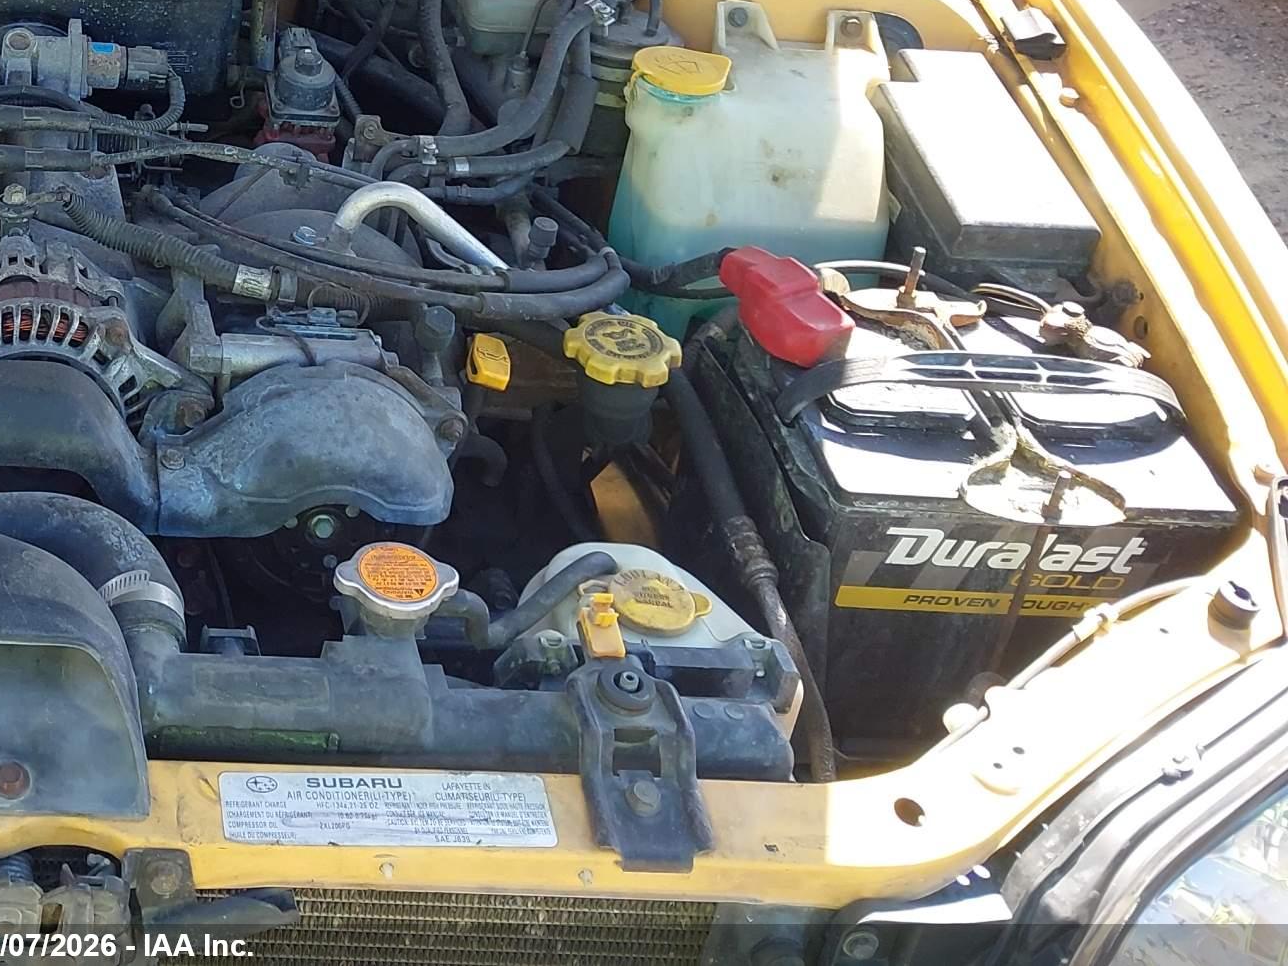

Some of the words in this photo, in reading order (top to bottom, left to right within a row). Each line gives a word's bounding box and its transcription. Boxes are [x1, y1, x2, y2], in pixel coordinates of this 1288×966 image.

[903, 594, 1000, 608] PROVEN
[1009, 598, 1086, 611] OUGH
[306, 777, 402, 788] SUBARU
[441, 782, 481, 791] LAFAYETTE
[287, 790, 303, 801] AIR
[434, 835, 450, 843] SAE
